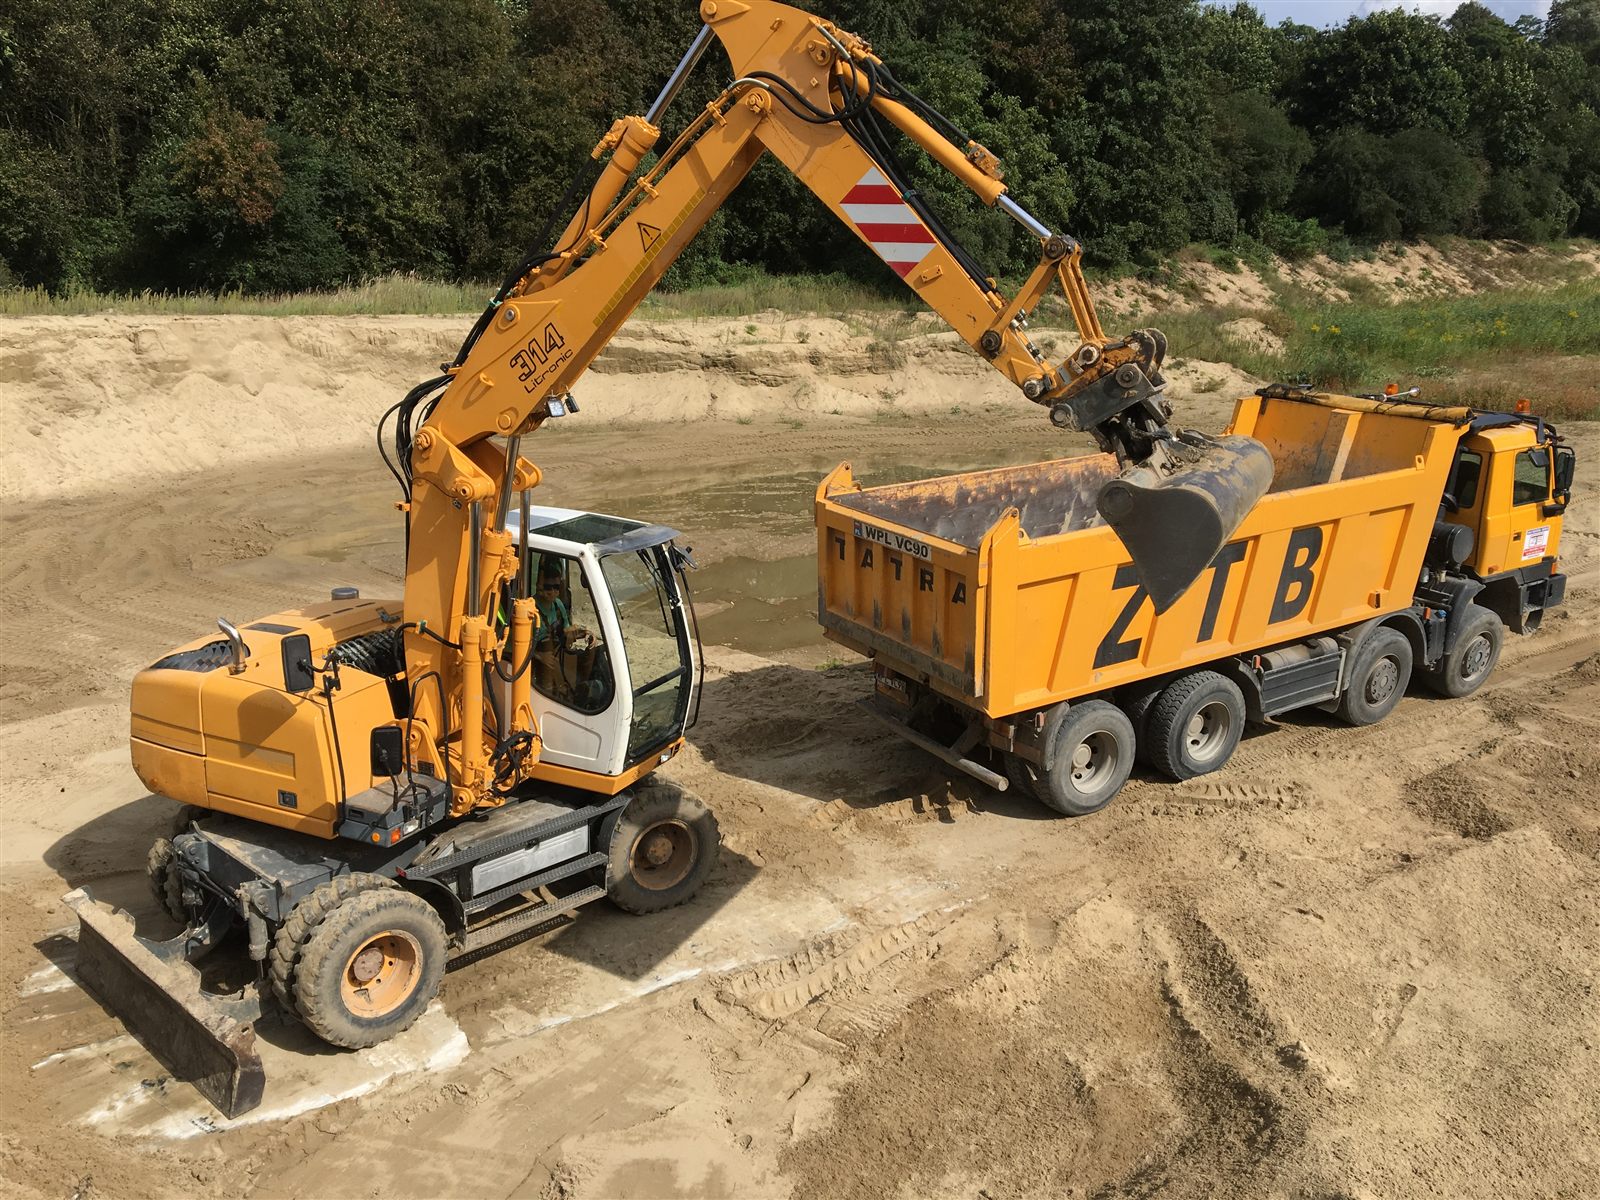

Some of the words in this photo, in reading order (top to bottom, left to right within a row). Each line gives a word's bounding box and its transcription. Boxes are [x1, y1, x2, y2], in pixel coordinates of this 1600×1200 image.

[509, 322, 565, 382] 314
[524, 348, 573, 394] Litronic
[835, 537, 967, 605] TATRA
[865, 525, 892, 545] WPL
[896, 536, 929, 559] VC90
[1093, 526, 1323, 670] ZTB
